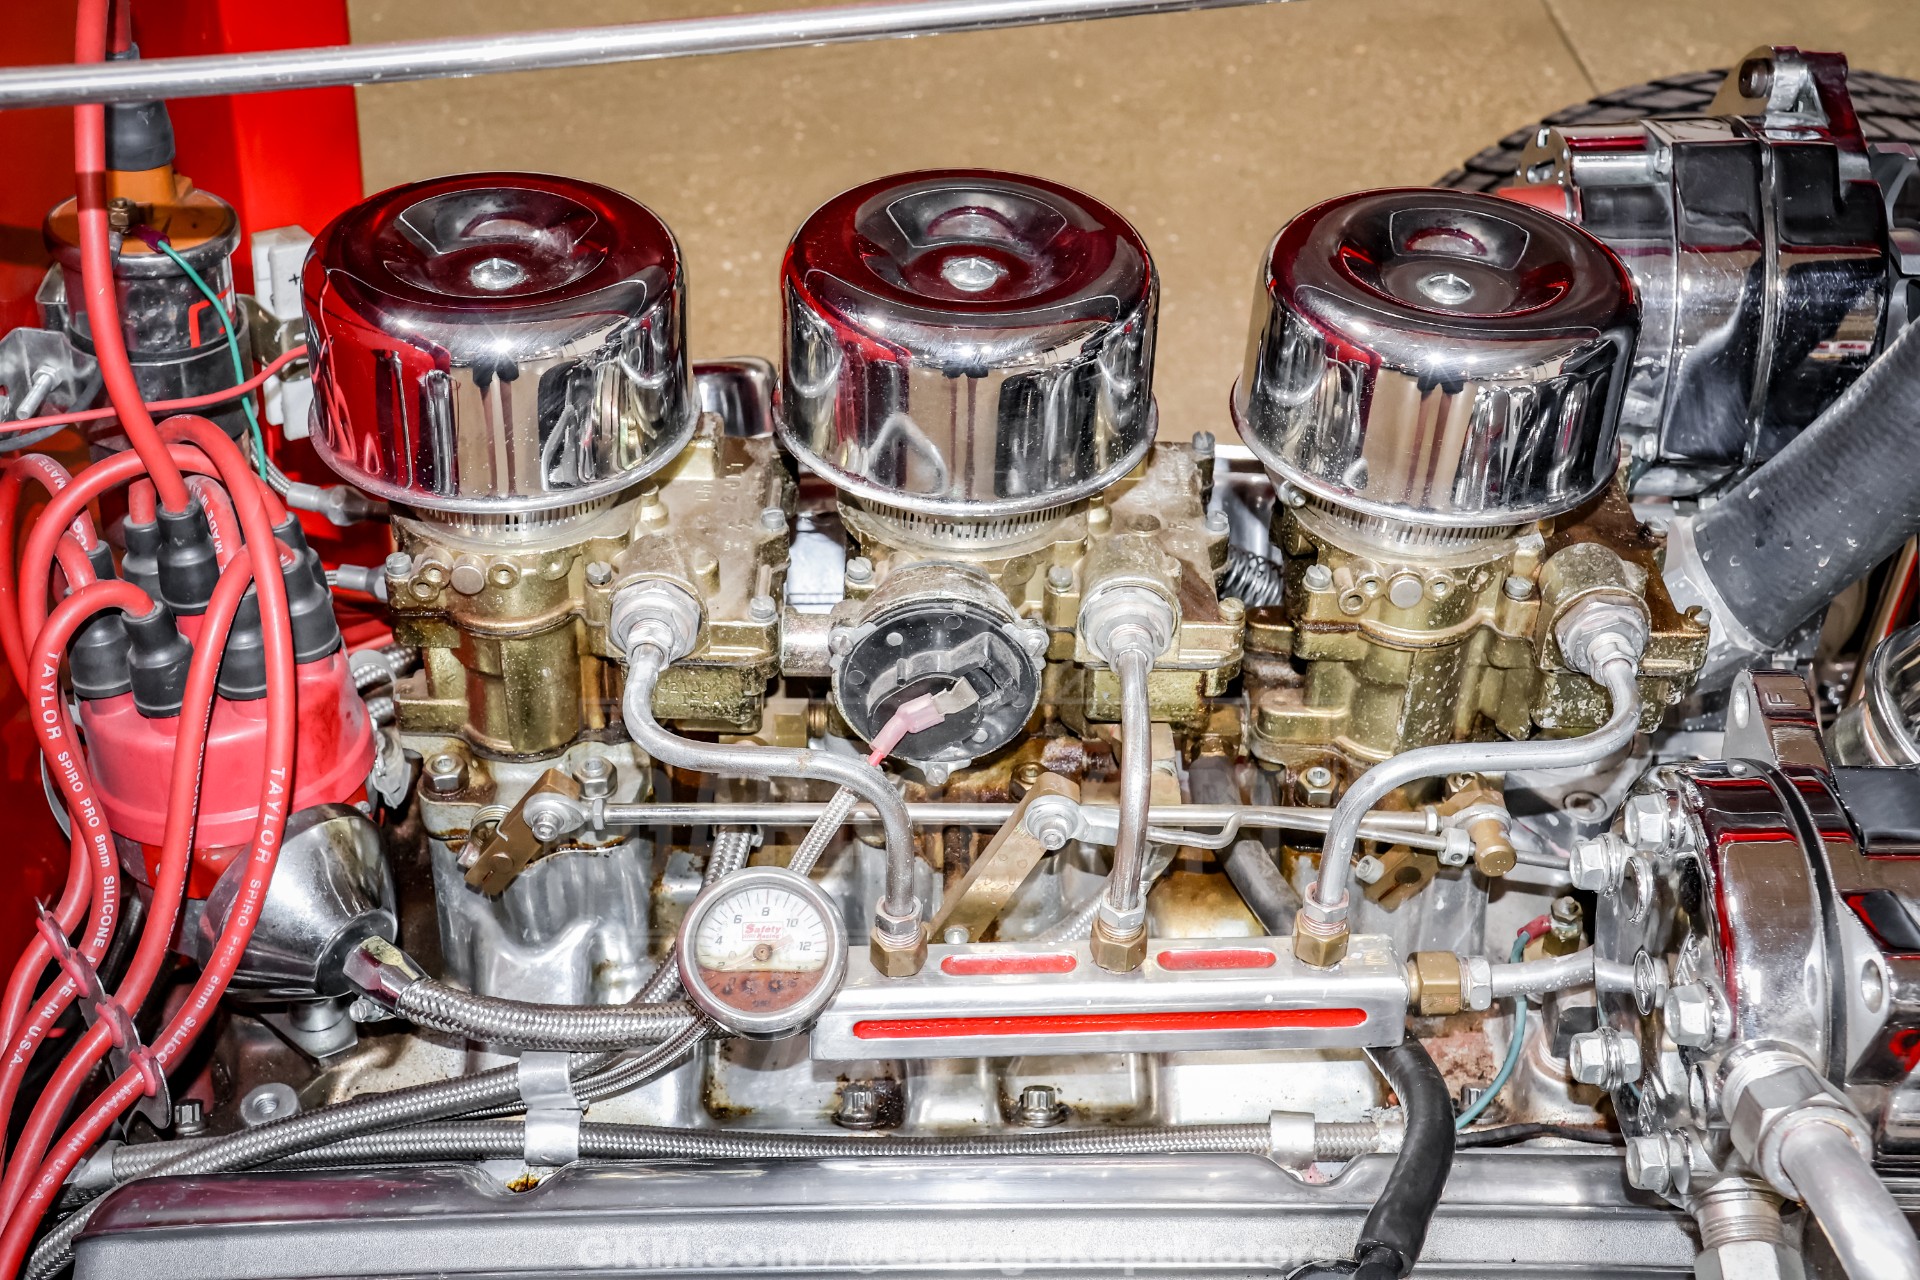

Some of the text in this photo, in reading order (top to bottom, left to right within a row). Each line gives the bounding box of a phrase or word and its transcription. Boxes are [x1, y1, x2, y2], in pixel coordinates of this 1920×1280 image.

[38, 458, 67, 490] MADE
[206, 509, 223, 554] MADE
[40, 651, 62, 740] TAYLOR
[57, 751, 84, 793] SPIRO
[80, 798, 100, 828] PRO
[255, 767, 286, 864] TAYLOR
[94, 834, 111, 868] 8mm
[92, 875, 115, 948] SILICONE
[237, 878, 262, 928] SPIRO
[733, 914, 743, 924] 6
[761, 906, 771, 916] 8
[744, 924, 782, 934] Safety
[786, 918, 799, 928] 10
[218, 935, 241, 969] PRO
[715, 936, 723, 945] 4
[799, 941, 812, 951] 12
[195, 975, 221, 1010] 8mm
[40, 1001, 59, 1019] IN
[8, 1025, 42, 1069] U.S.A.
[67, 1132, 86, 1152] IN
